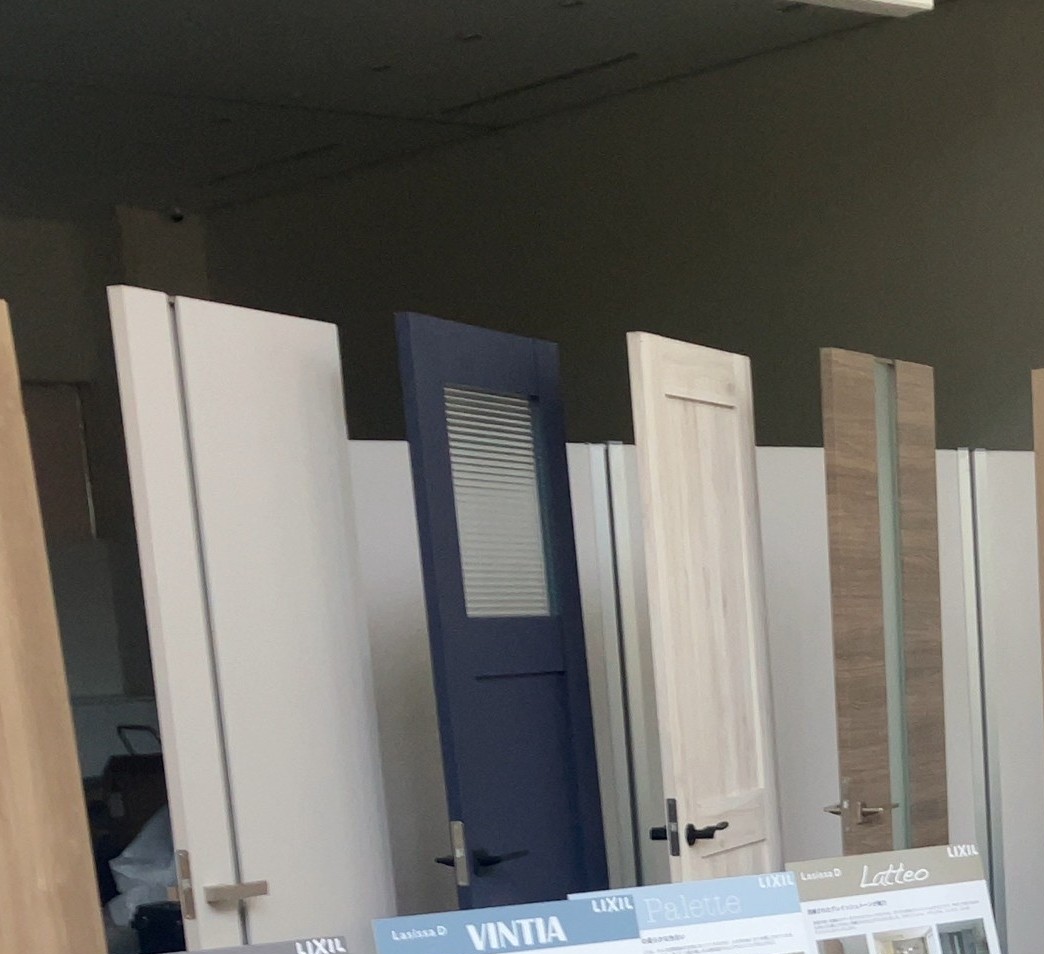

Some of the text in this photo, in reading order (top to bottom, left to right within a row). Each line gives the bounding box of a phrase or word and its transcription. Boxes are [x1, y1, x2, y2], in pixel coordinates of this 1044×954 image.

[947, 844, 979, 858] LIXIL
[758, 873, 795, 889] LIXIL
[859, 862, 930, 890] Latteo
[591, 896, 635, 913] LIXIL
[643, 893, 742, 923] Palette
[391, 915, 568, 951] Lasissa D VINTIA
